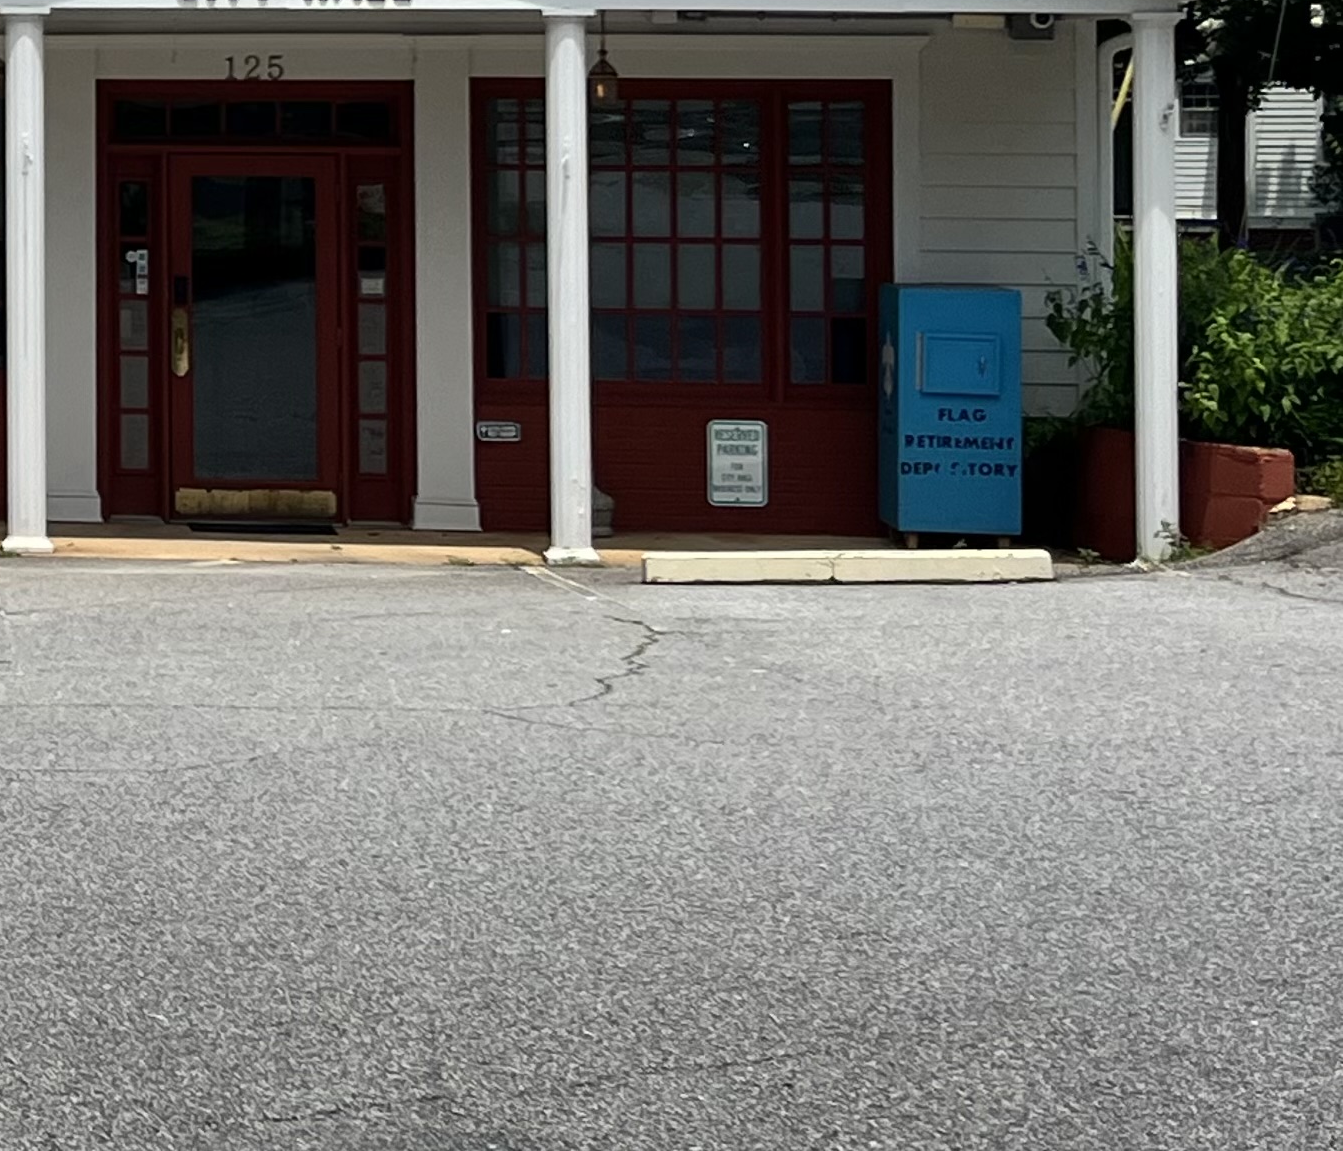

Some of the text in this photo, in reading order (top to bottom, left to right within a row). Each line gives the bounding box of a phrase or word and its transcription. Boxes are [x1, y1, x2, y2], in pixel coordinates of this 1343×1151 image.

[224, 54, 285, 80] 125
[937, 408, 987, 422] FLAG
[900, 461, 1018, 478] DEPSTORY
